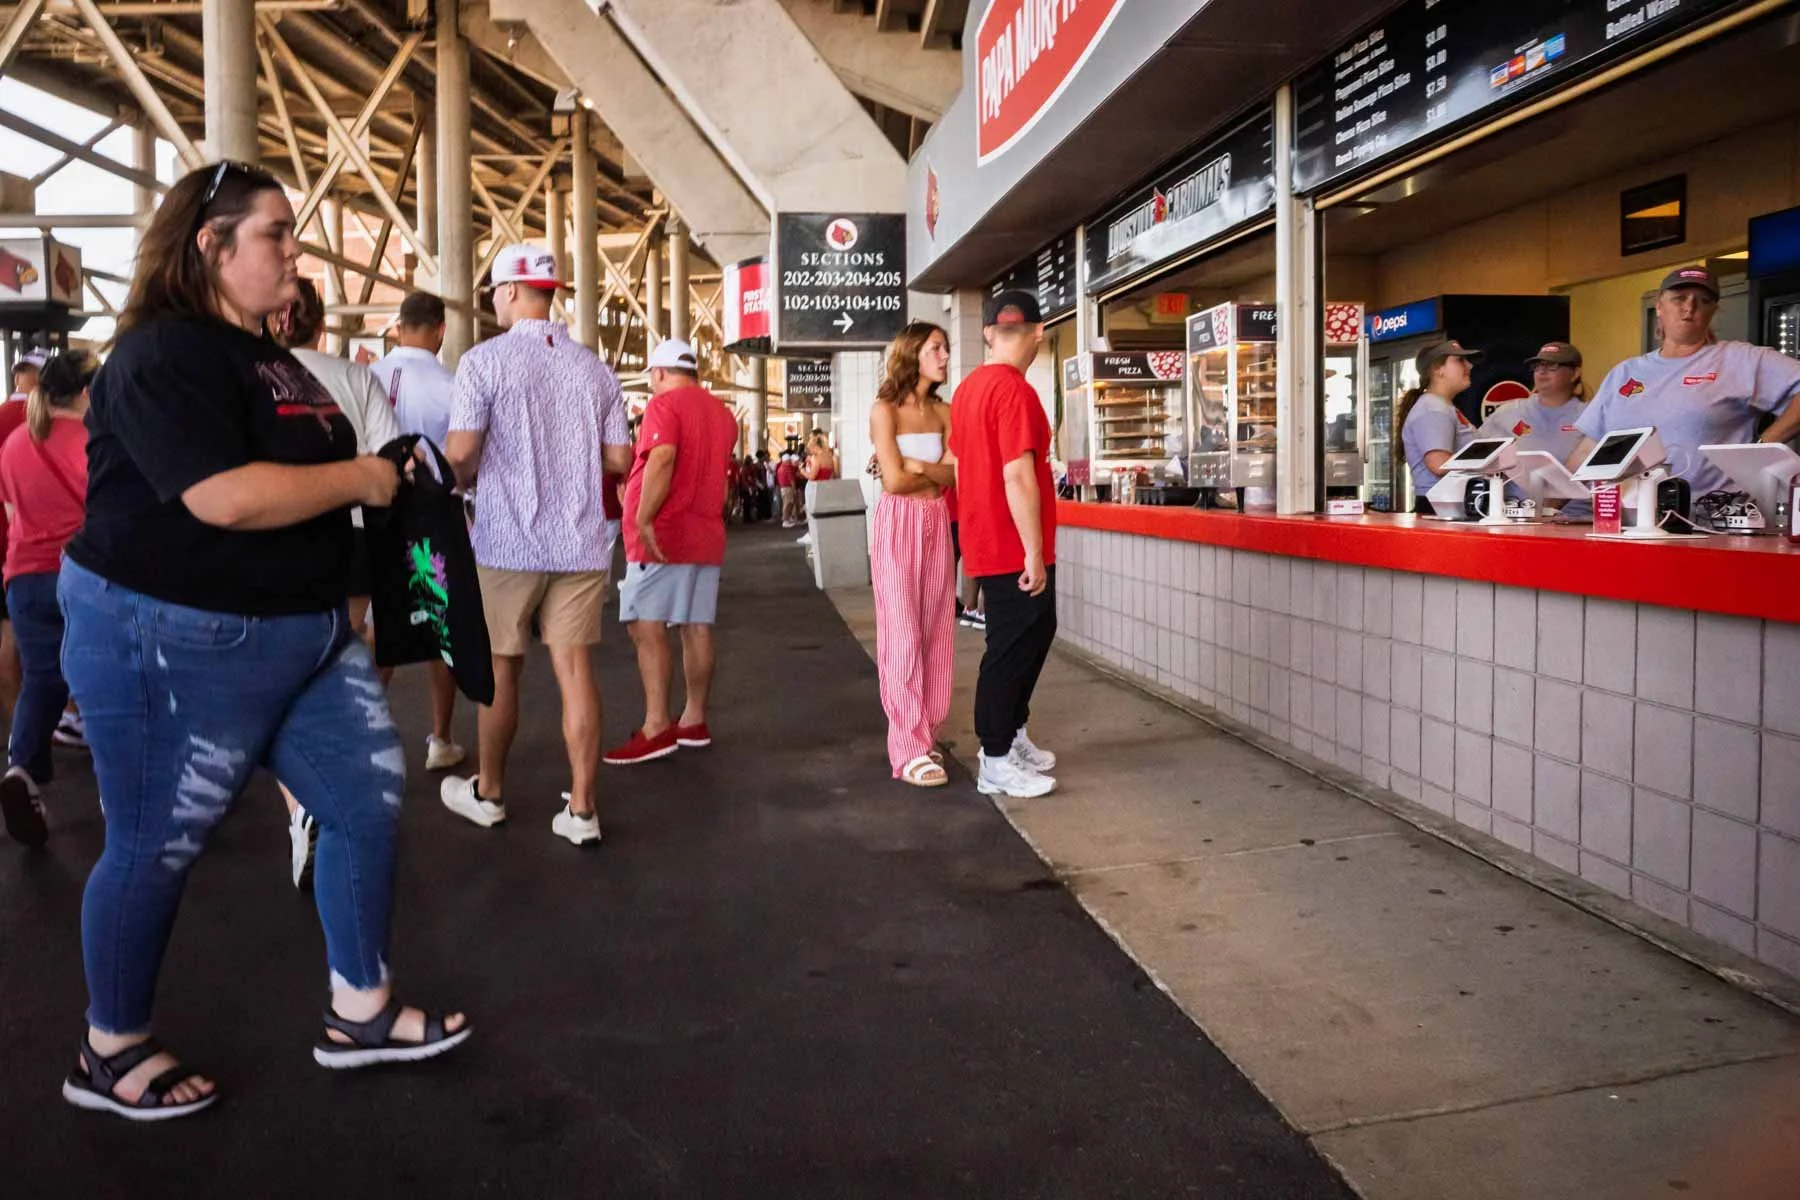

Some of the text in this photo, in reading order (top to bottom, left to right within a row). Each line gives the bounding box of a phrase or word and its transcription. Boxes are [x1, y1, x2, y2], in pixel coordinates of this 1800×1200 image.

[1606, 7, 1645, 39] Bottled
[982, 22, 1014, 125] PAPA
[1363, 68, 1379, 85] Pizza
[1379, 58, 1395, 76] Slice
[1377, 82, 1394, 99] Pizza
[1394, 72, 1411, 90] Slice
[1335, 127, 1355, 145] Cheese
[1356, 119, 1370, 135] Pizza
[1371, 110, 1387, 127] Slice
[1166, 155, 1231, 223] CARDINALS
[800, 252, 885, 267] SECTIONS
[1382, 311, 1407, 334] pepsi
[798, 364, 831, 373] SECTIO
[1104, 356, 1131, 366] FRESH
[1118, 367, 1143, 376] PIZZA
